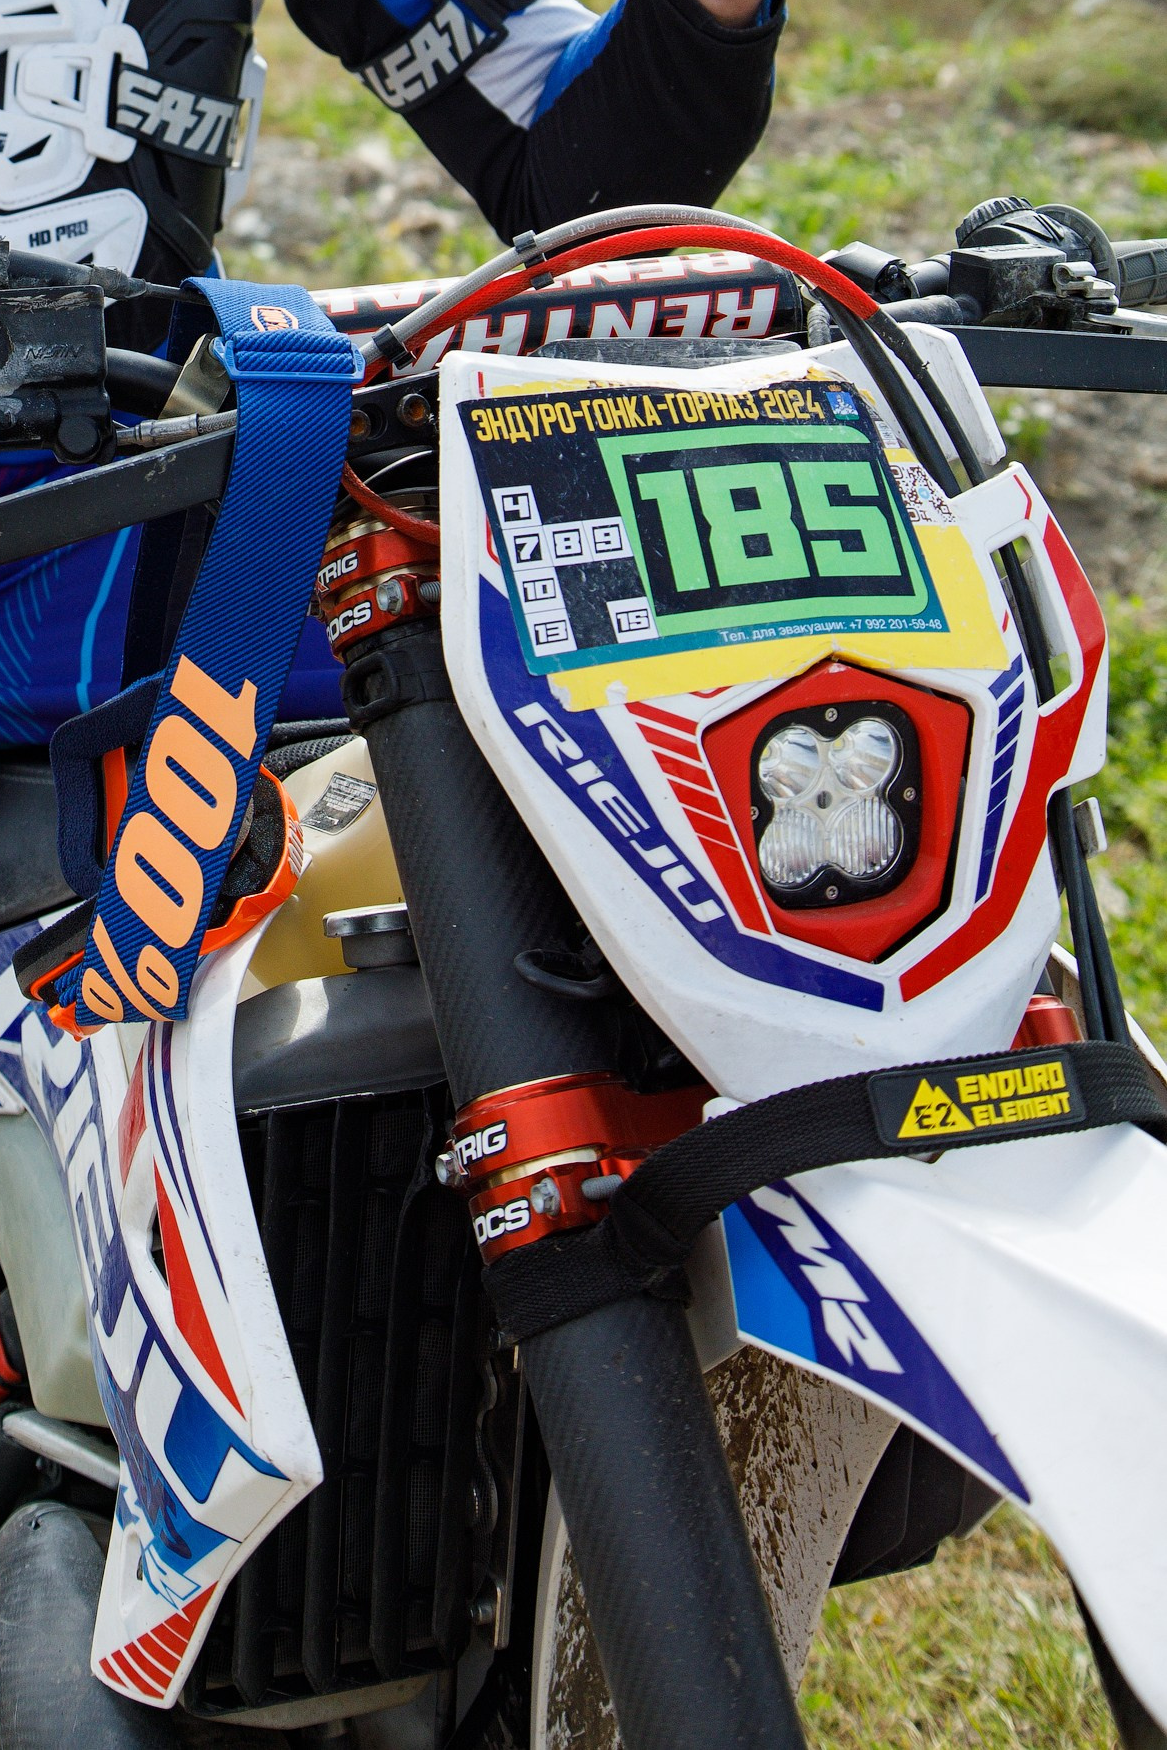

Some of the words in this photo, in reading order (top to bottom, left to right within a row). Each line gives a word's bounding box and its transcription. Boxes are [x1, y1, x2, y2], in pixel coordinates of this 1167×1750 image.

[116, 69, 235, 158] EATT
[29, 229, 52, 248] HD
[55, 219, 90, 242] PRO
[761, 388, 825, 421] 2024
[502, 493, 531, 522] 4
[514, 533, 542, 563] 7
[552, 529, 583, 558] 8
[592, 524, 623, 553] 9
[636, 460, 901, 593] 185
[523, 577, 556, 602] 10
[534, 620, 569, 645] 13
[616, 609, 651, 633] 15
[720, 630, 750, 643] Тел.
[752, 628, 777, 641] для
[778, 620, 847, 636] эвакуации:
[849, 619, 863, 630] +7
[865, 618, 887, 630] 992
[889, 618, 942, 630] 201-59-48
[513, 701, 726, 926] RIEJU
[81, 653, 258, 1022] 100%
[956, 1060, 1067, 1104] ENDURO
[914, 1102, 957, 1130] E2
[971, 1091, 1071, 1128] ELEMENT
